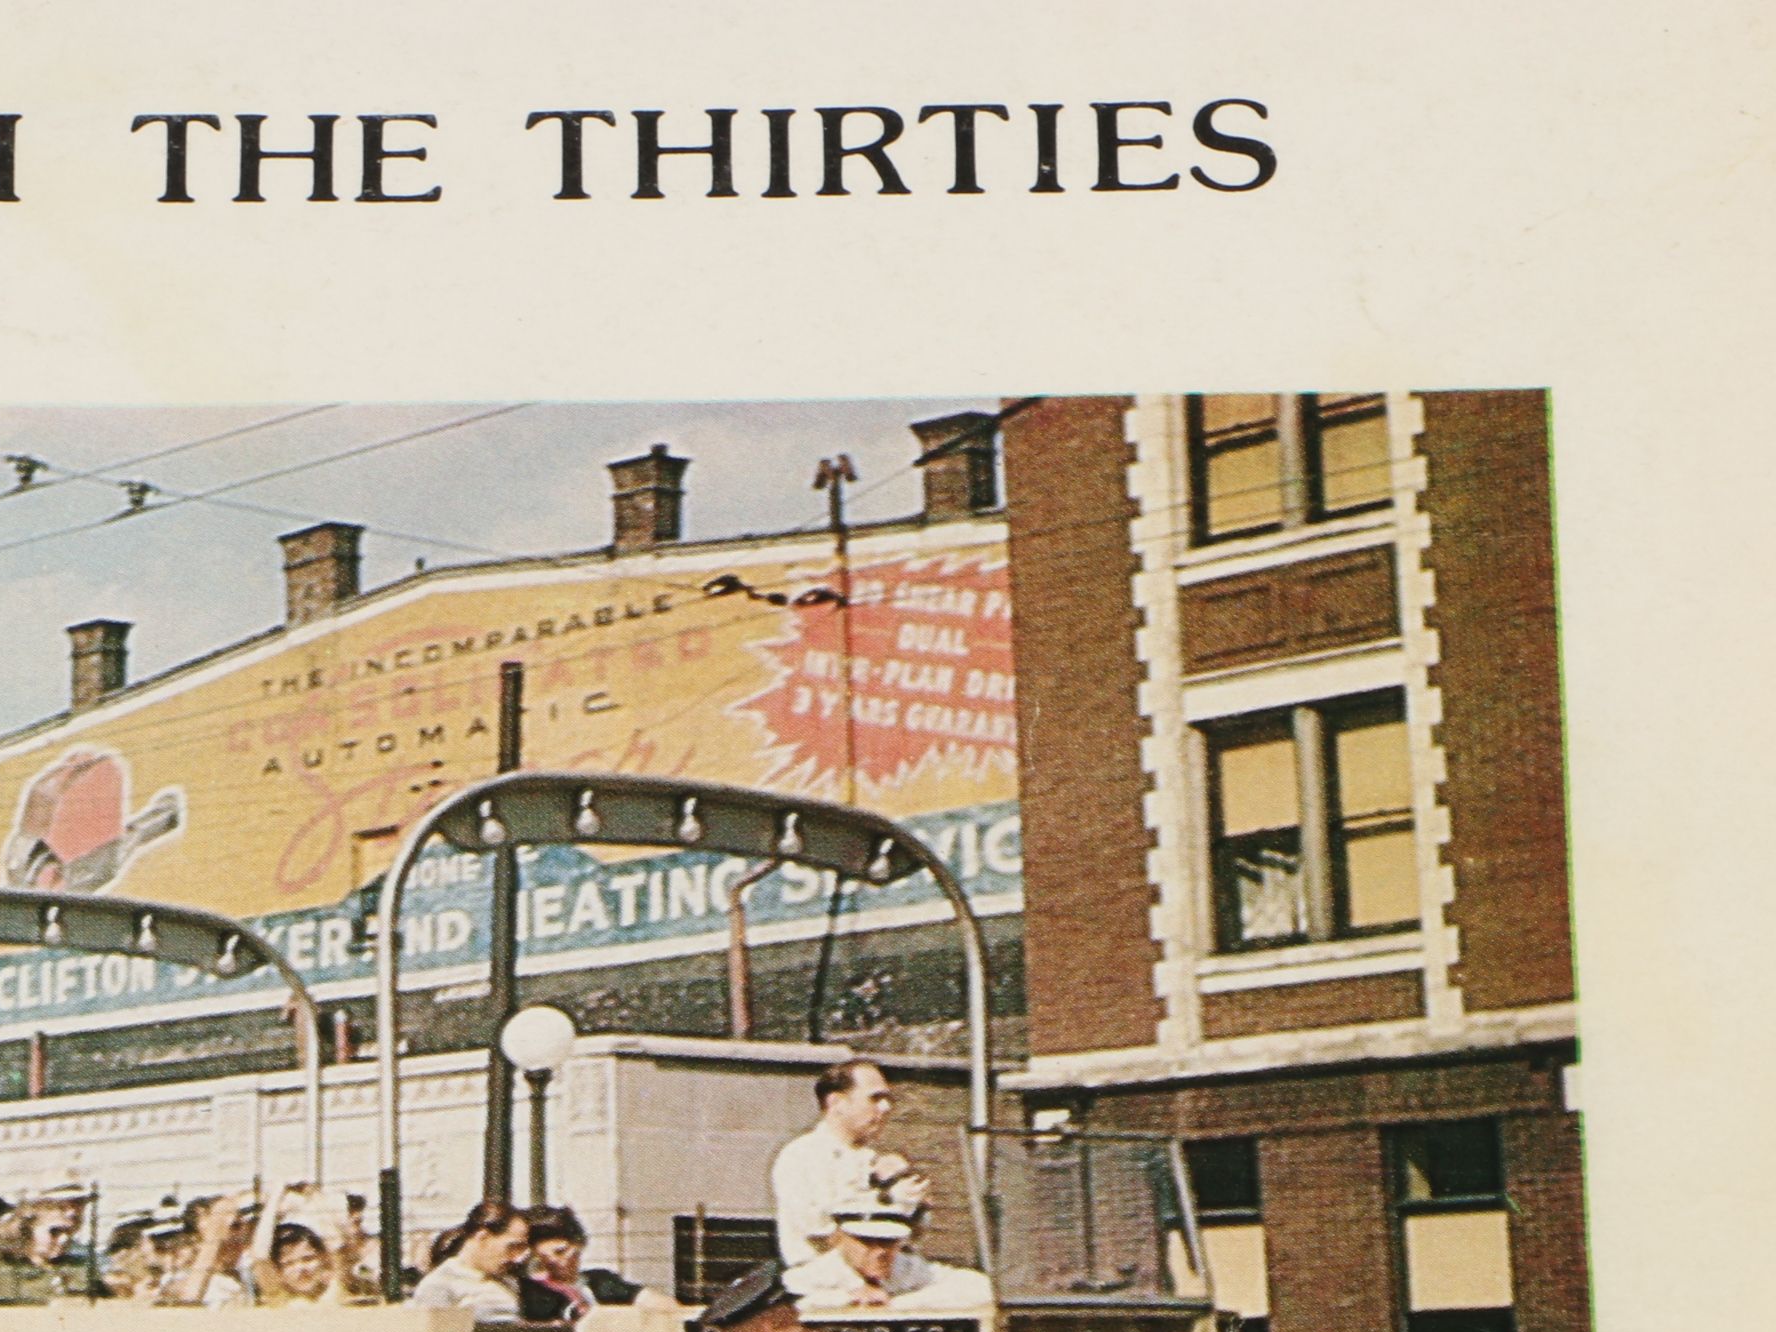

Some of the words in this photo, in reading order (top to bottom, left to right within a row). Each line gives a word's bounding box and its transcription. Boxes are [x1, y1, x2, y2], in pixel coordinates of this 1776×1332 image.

[130, 114, 442, 203] THE
[525, 98, 1277, 200] THIRTIES
[260, 667, 326, 699] THE
[348, 594, 678, 681] INCOMPARABLE
[803, 649, 955, 695] INTR-PLAN
[896, 622, 971, 657] DUAL
[260, 689, 624, 776] AUTOMAIC
[819, 688, 901, 728] YARS
[780, 815, 1023, 905] SVIC
